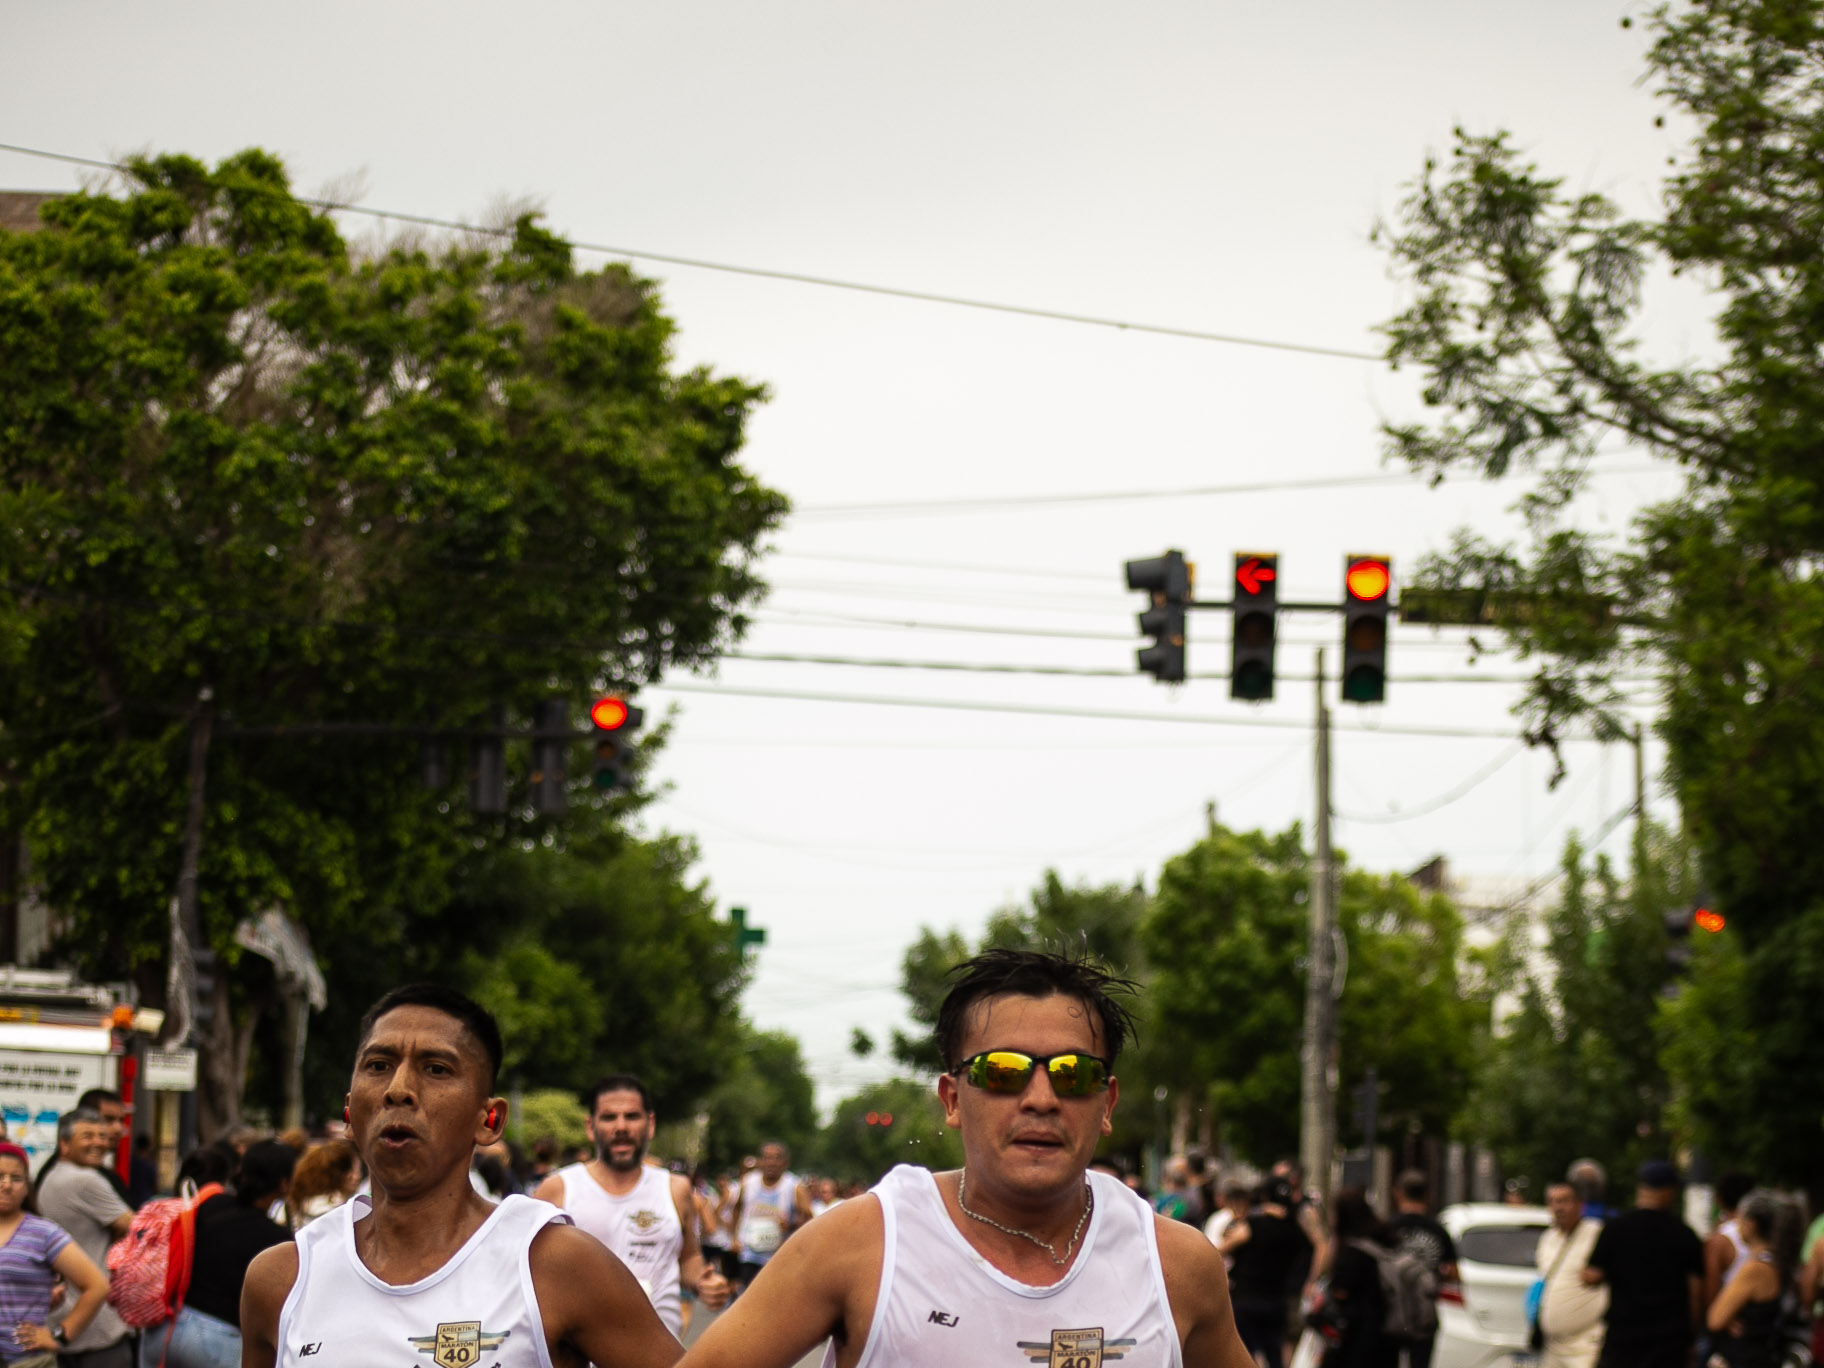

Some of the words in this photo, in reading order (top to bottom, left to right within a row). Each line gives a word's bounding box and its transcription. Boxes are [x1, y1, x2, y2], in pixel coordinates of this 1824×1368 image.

[928, 1310, 959, 1327] NEJ
[299, 1342, 322, 1357] NEJ
[443, 1348, 470, 1363] 40
